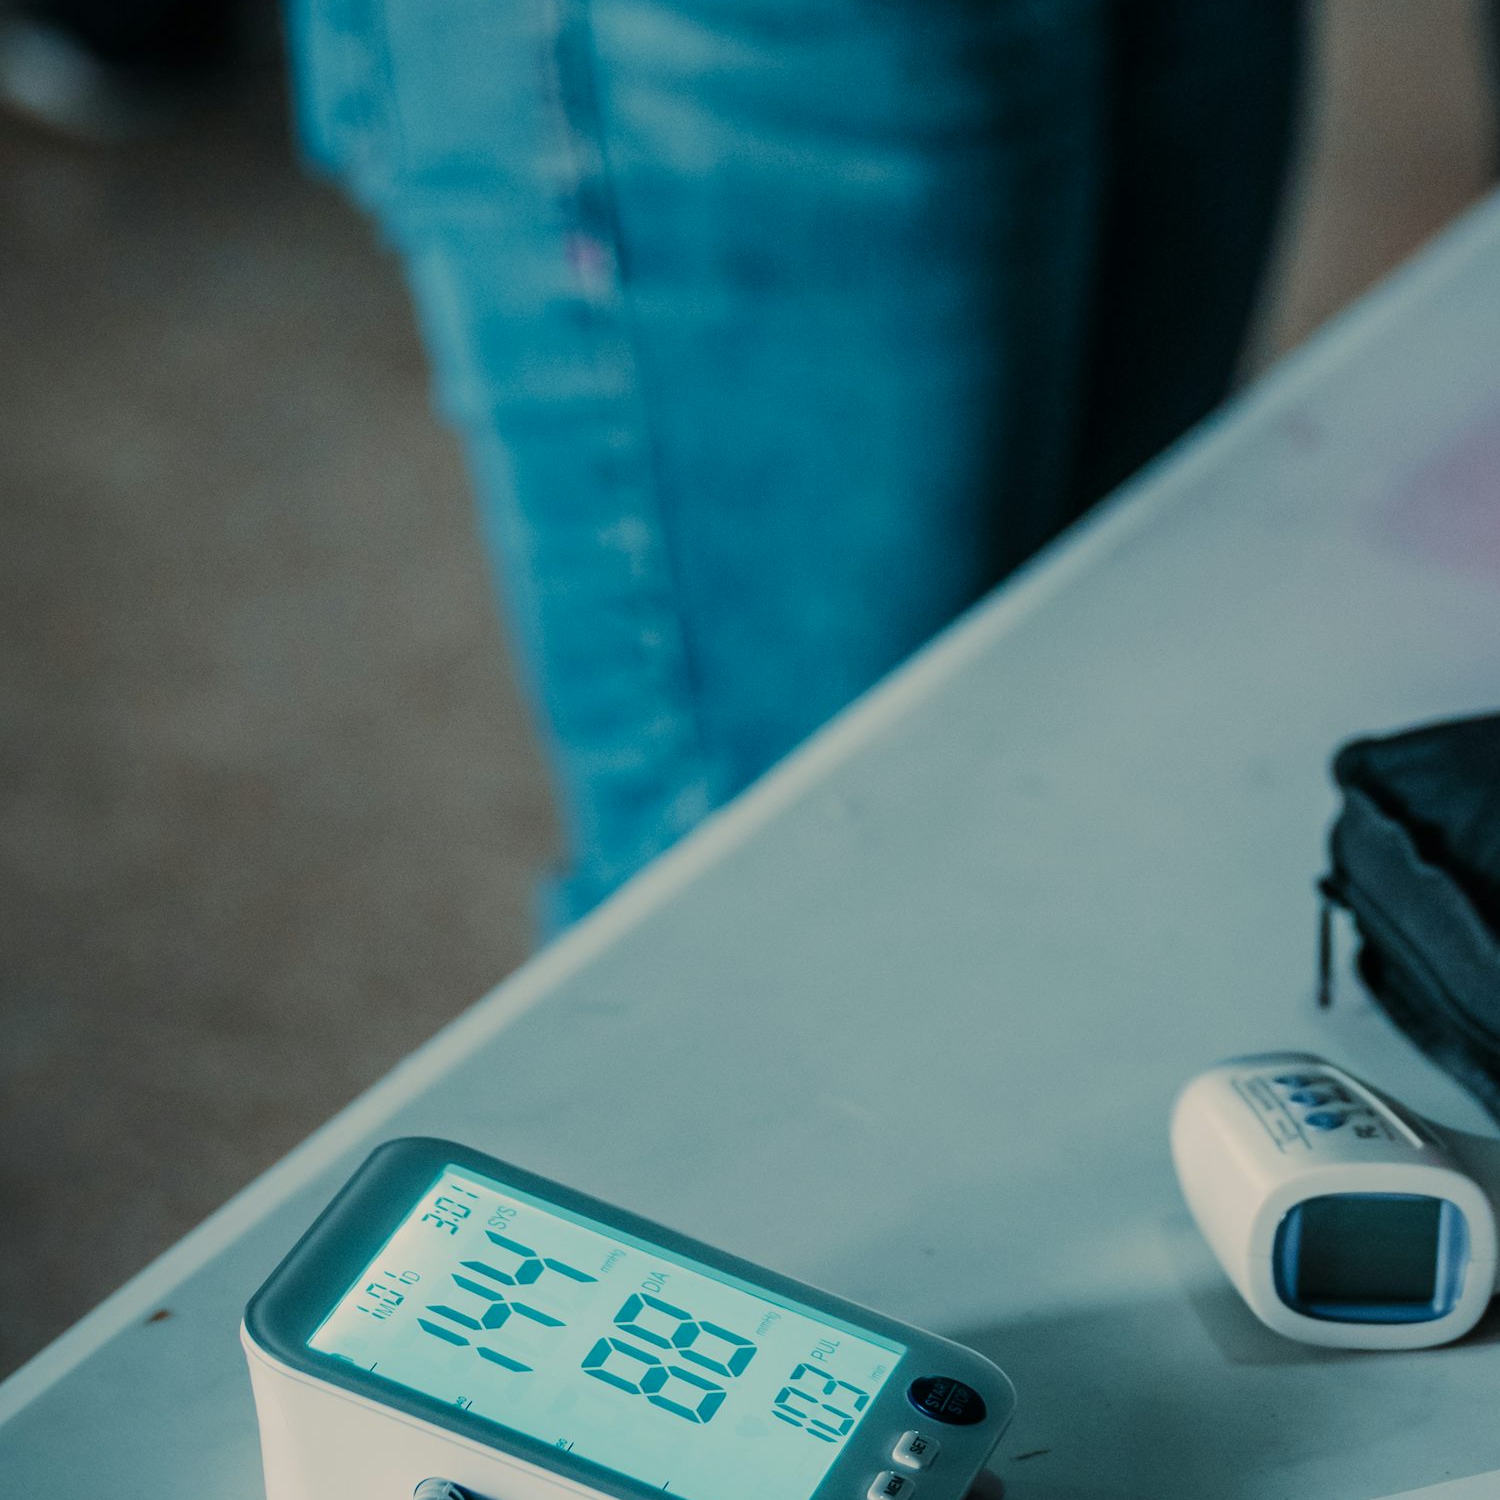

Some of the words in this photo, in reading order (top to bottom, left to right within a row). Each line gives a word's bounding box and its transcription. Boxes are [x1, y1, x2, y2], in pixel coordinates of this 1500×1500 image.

[421, 1184, 480, 1235] 3:01
[487, 1205, 517, 1230] SYS
[600, 1248, 627, 1274] mmHg
[641, 1270, 671, 1293] DIA
[416, 1229, 600, 1373] 144
[756, 1311, 782, 1337] mmHg
[580, 1292, 758, 1424] 88
[810, 1339, 841, 1363] PUL
[770, 1362, 871, 1443] 103
[924, 1377, 951, 1409] START
[949, 1387, 972, 1416] STOP
[909, 1435, 928, 1455] SET
[884, 1475, 905, 1497] MEM
